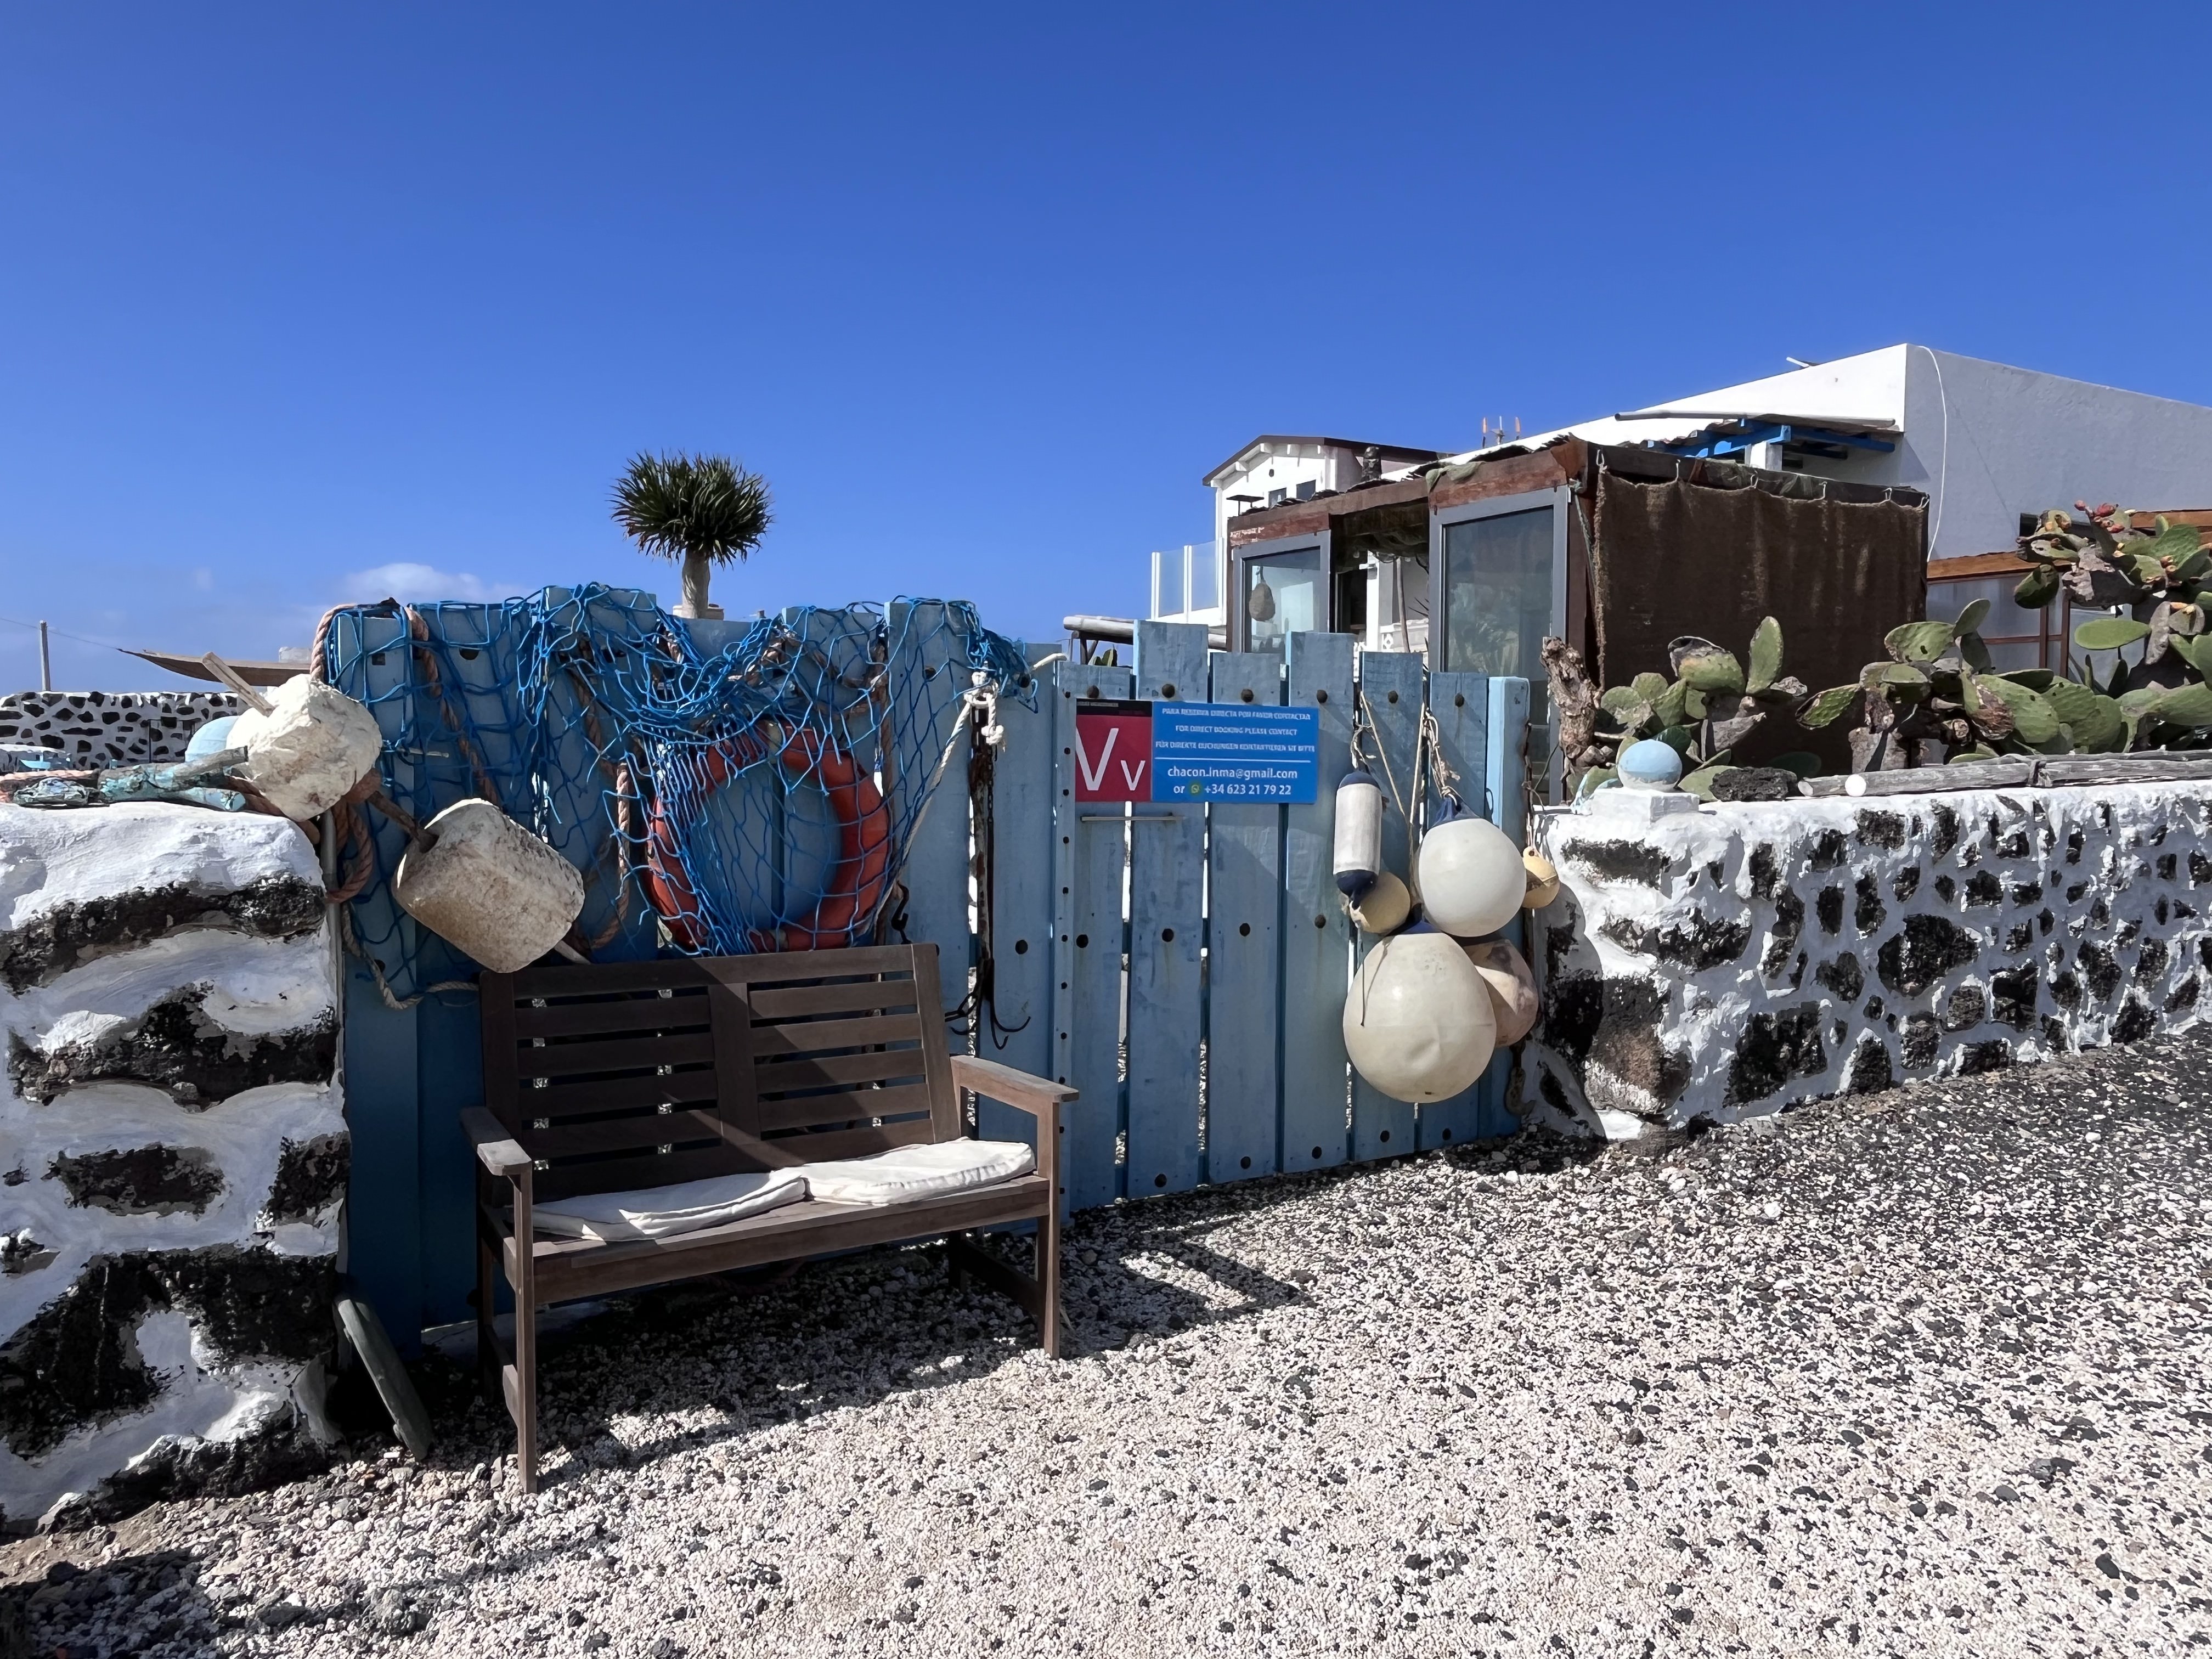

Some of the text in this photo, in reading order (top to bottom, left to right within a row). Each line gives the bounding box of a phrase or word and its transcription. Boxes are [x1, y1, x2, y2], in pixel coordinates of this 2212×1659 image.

[1167, 766, 1298, 780] chacon.inma@gmail.com
[1173, 784, 1291, 795] or +34 623 21 79 22
